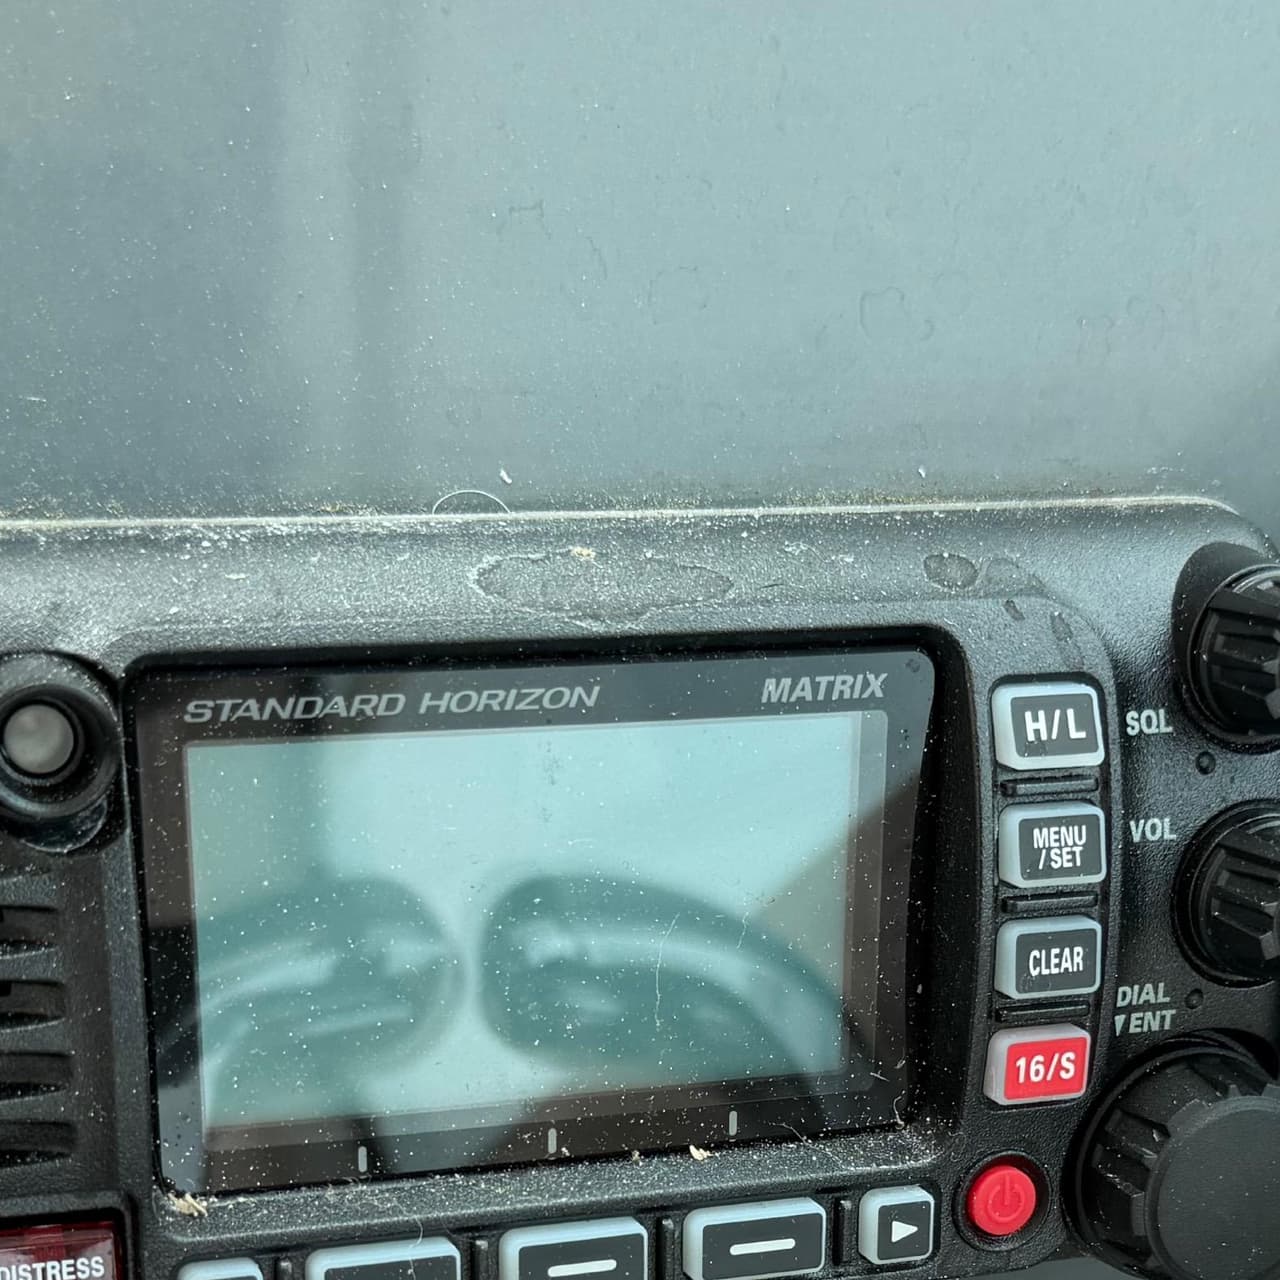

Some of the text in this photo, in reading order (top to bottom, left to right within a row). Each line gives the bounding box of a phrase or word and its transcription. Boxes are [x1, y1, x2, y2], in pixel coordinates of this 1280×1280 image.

[761, 673, 888, 703] MATRIX
[183, 685, 601, 724] STANDARD HORIZON
[1024, 708, 1087, 742] H/L
[1125, 709, 1173, 736] SQL
[1033, 824, 1087, 849] MENU
[1129, 817, 1177, 843] VOL
[1038, 846, 1084, 870] /SET
[1028, 946, 1084, 977] CLEAR
[1116, 982, 1171, 1008] DIAL
[1128, 1009, 1177, 1034] ENT
[1015, 1051, 1076, 1084] 16/S
